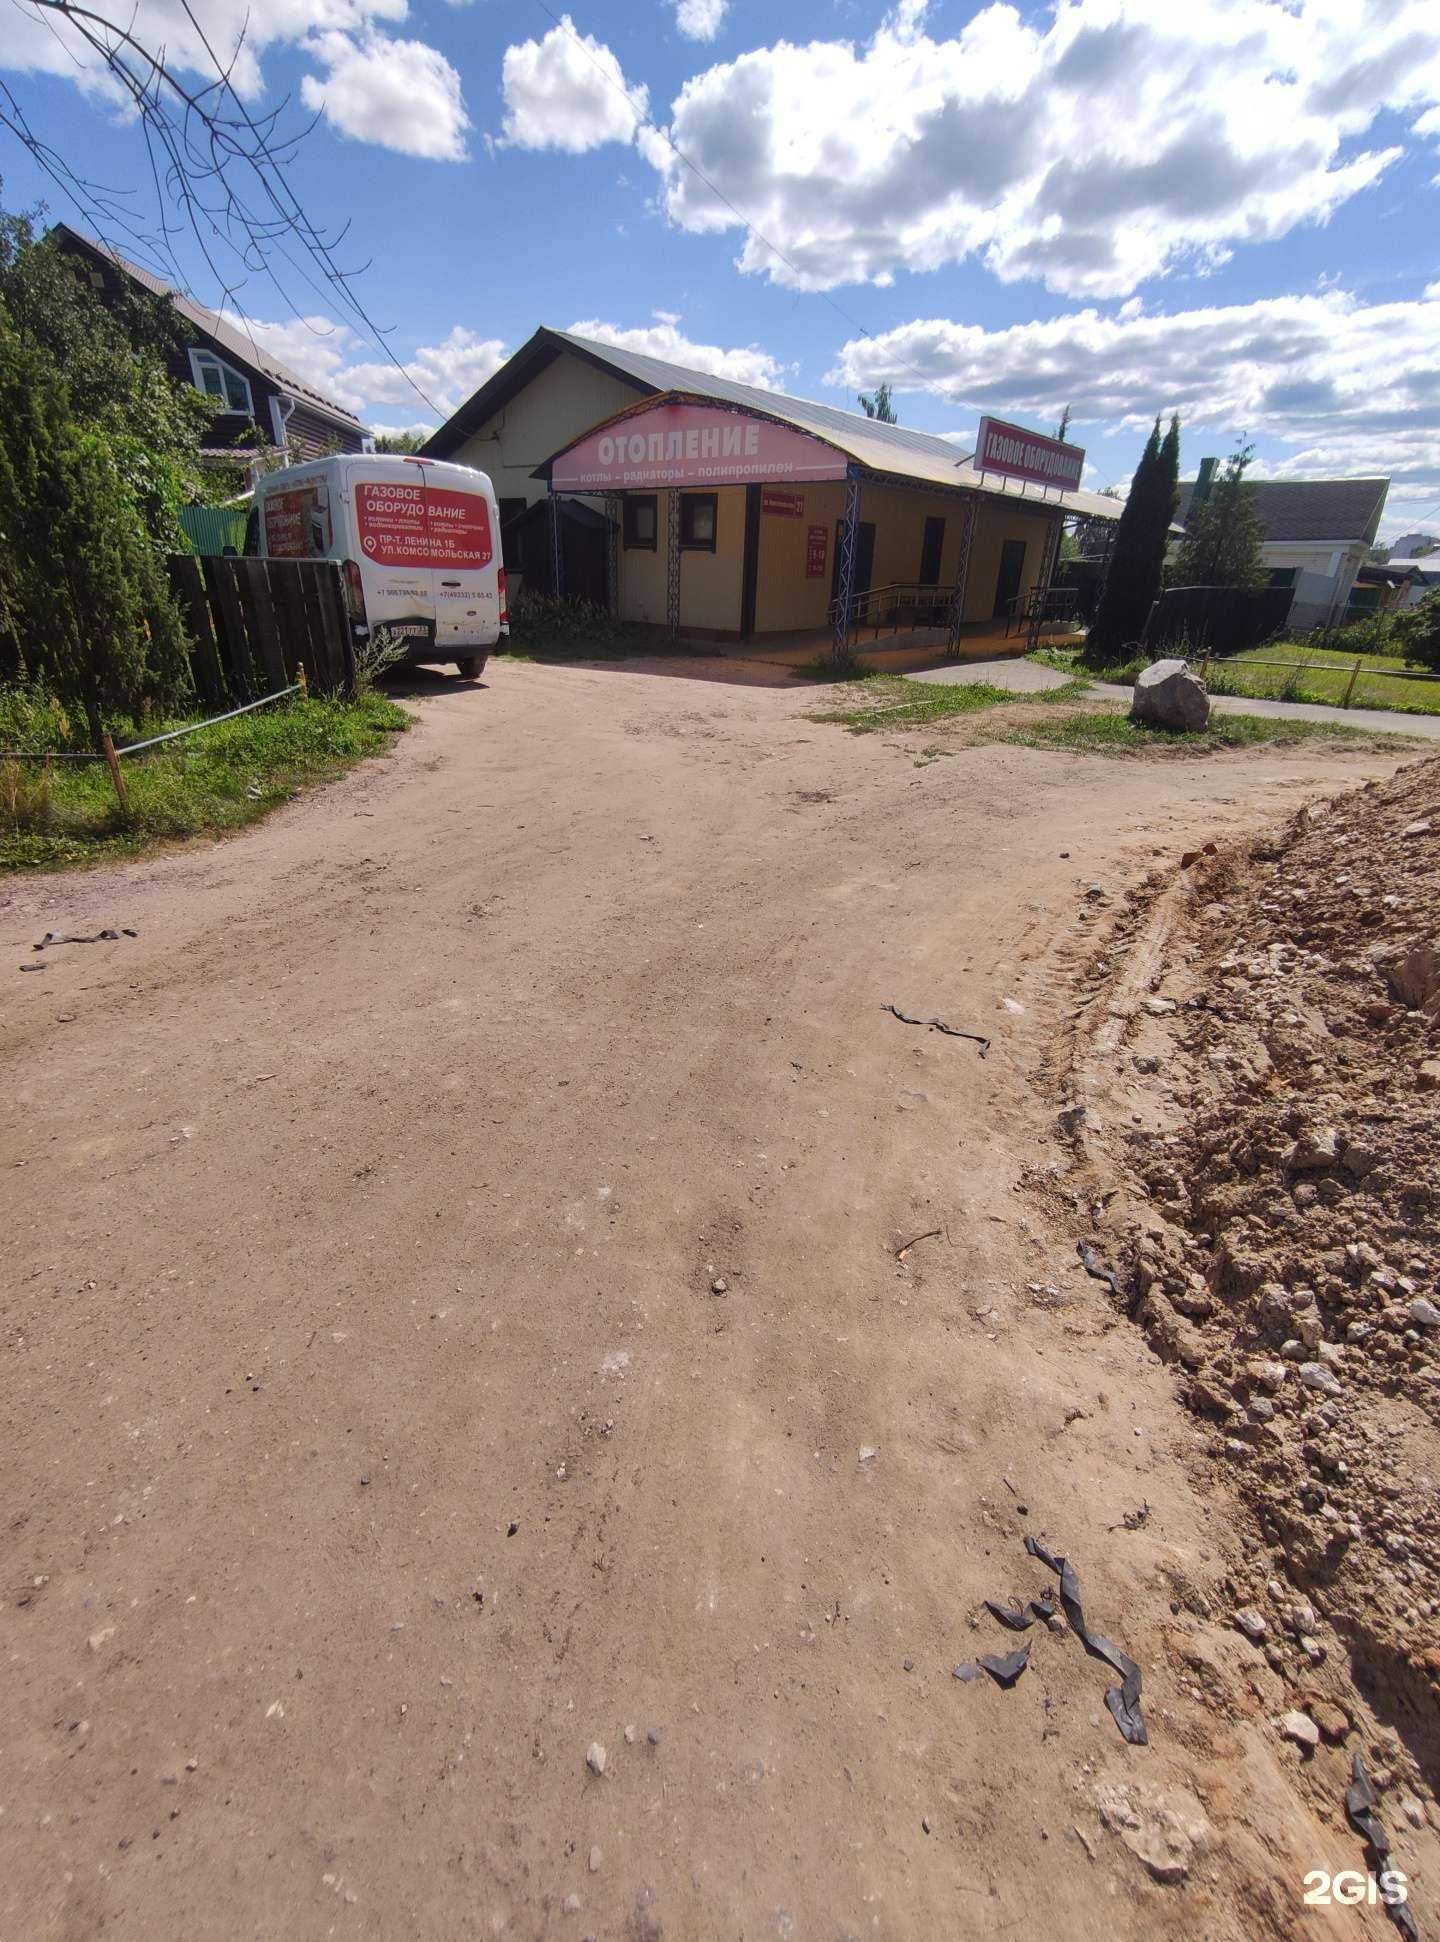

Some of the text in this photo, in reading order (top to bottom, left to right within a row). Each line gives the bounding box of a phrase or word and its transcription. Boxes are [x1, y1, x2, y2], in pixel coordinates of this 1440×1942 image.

[598, 425, 759, 466] ОТОПЛЕНИЕ
[985, 432, 1024, 466] ГАЗОВОЕ
[580, 462, 793, 484] котлы радиаторы полипропилен
[364, 485, 421, 500] ГАЗОВОЕ
[446, 540, 455, 548] 1Б
[482, 552, 491, 560] 27
